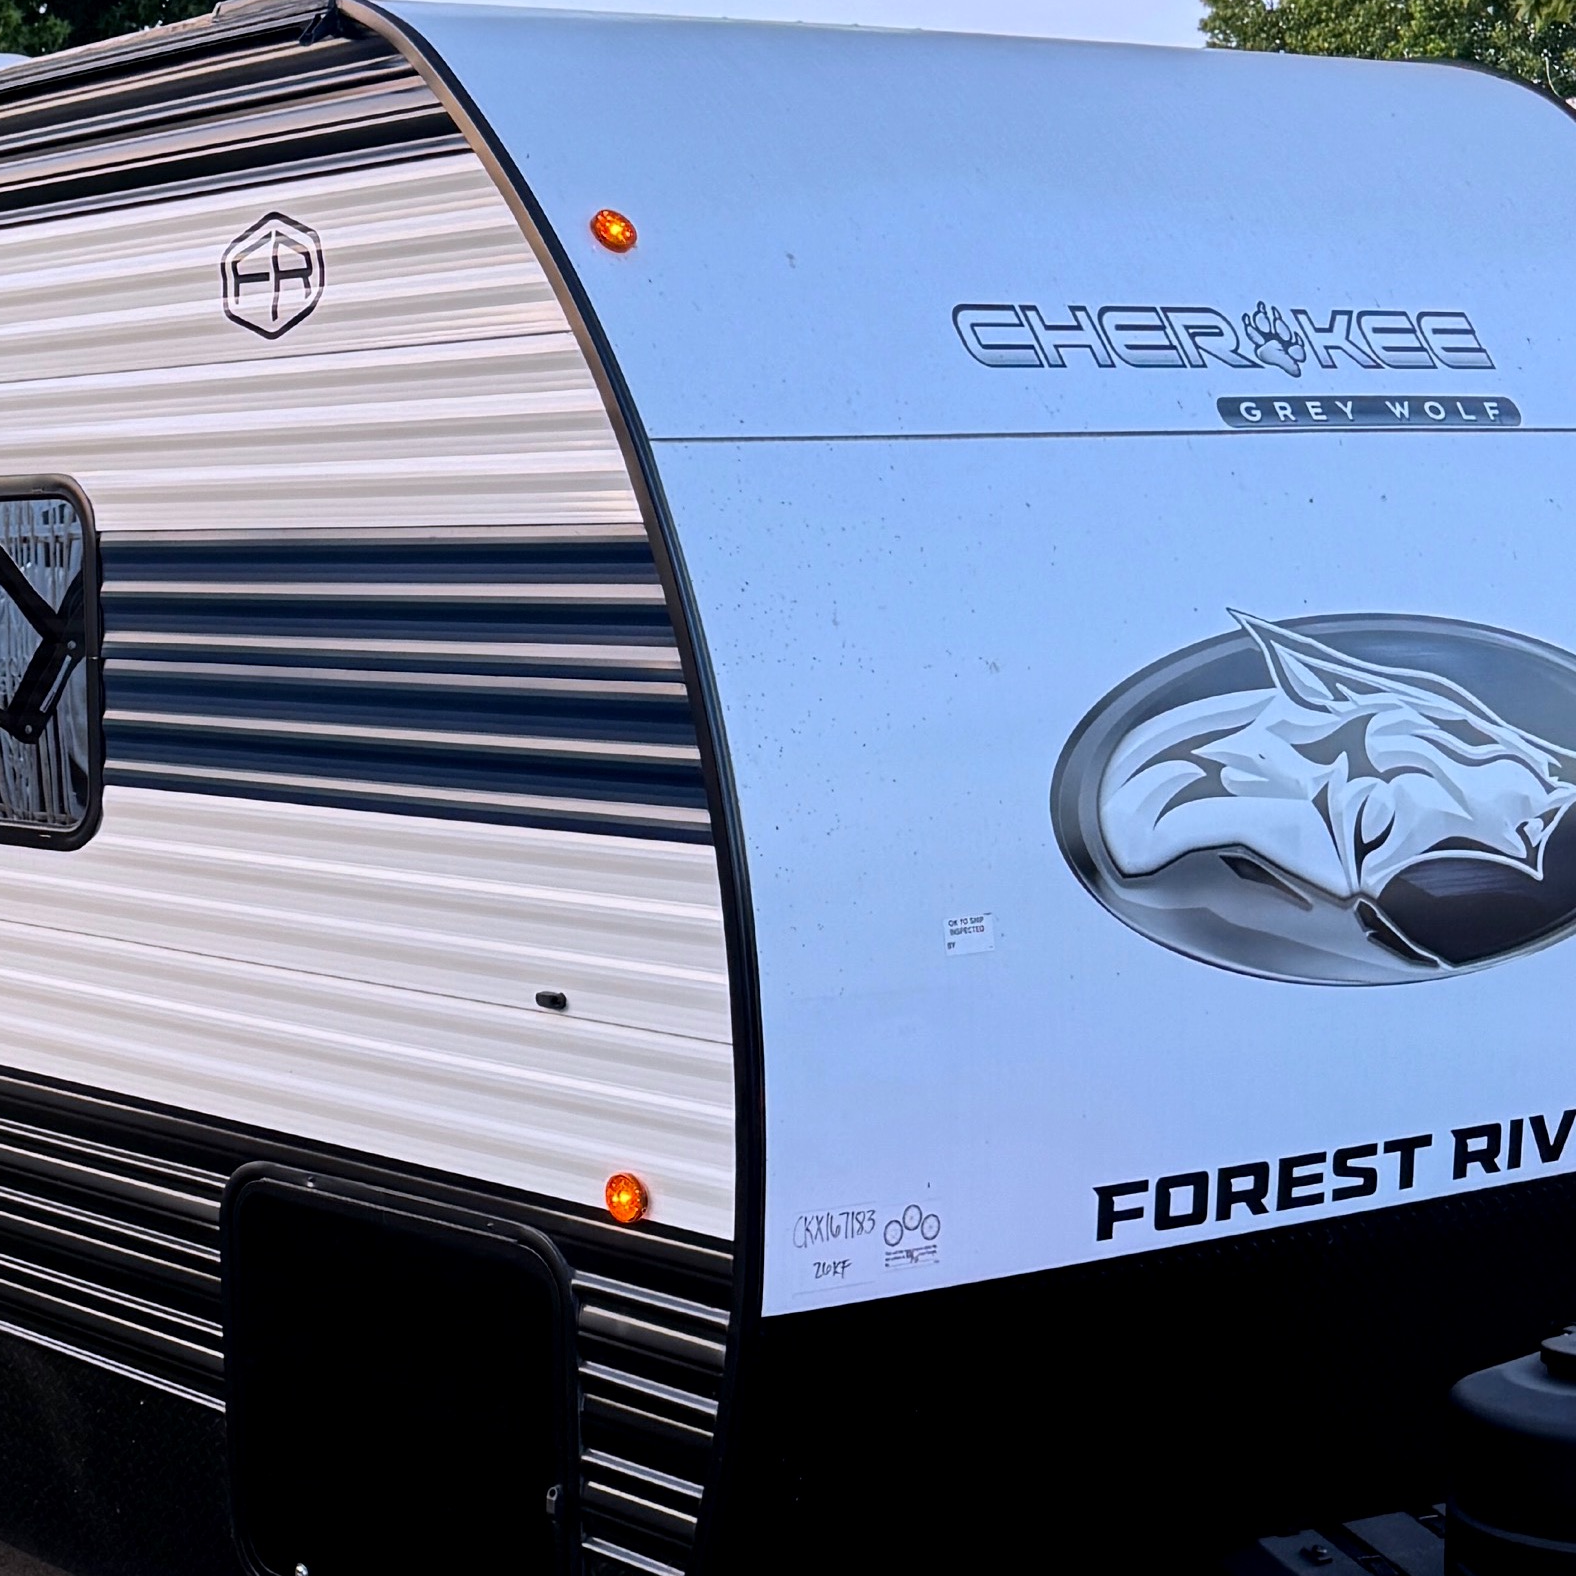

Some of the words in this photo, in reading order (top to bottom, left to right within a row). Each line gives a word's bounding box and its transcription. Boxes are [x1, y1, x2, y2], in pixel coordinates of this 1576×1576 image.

[951, 301, 1496, 377] CHEROKEE
[1239, 401, 1354, 422] GREY
[1385, 401, 1501, 421] WOLF
[1092, 1133, 1433, 1242] FOREST
